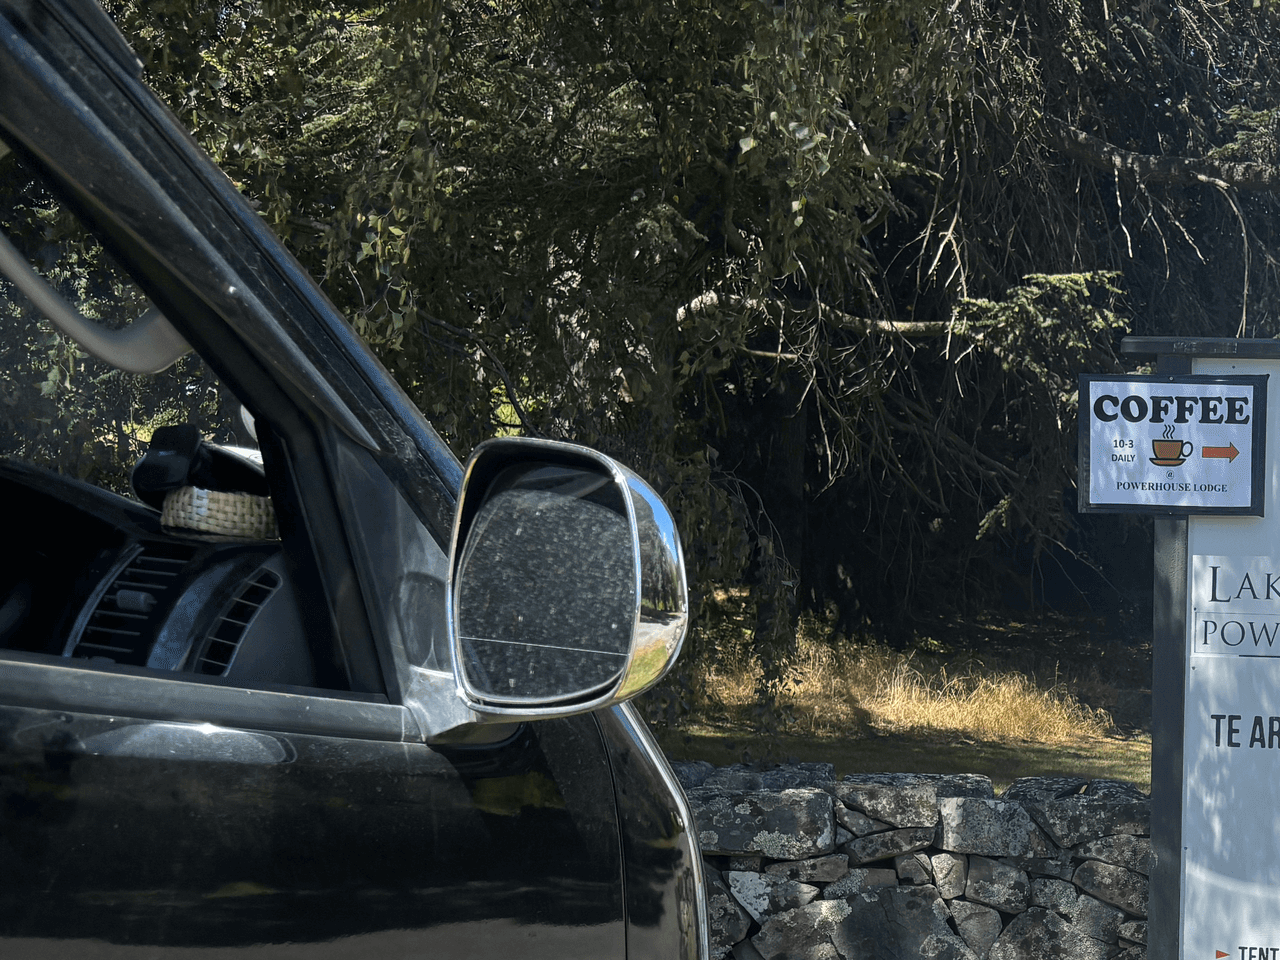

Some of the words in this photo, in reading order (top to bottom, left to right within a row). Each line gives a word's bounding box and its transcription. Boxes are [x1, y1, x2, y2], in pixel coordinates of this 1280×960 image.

[1093, 394, 1250, 425] COFFEE
[1113, 439, 1134, 449] 10-3
[1111, 453, 1136, 463] DAILY
[1116, 481, 1191, 492] POWERHOUSE
[1193, 483, 1228, 493] LODGE
[1210, 714, 1241, 748] TE
